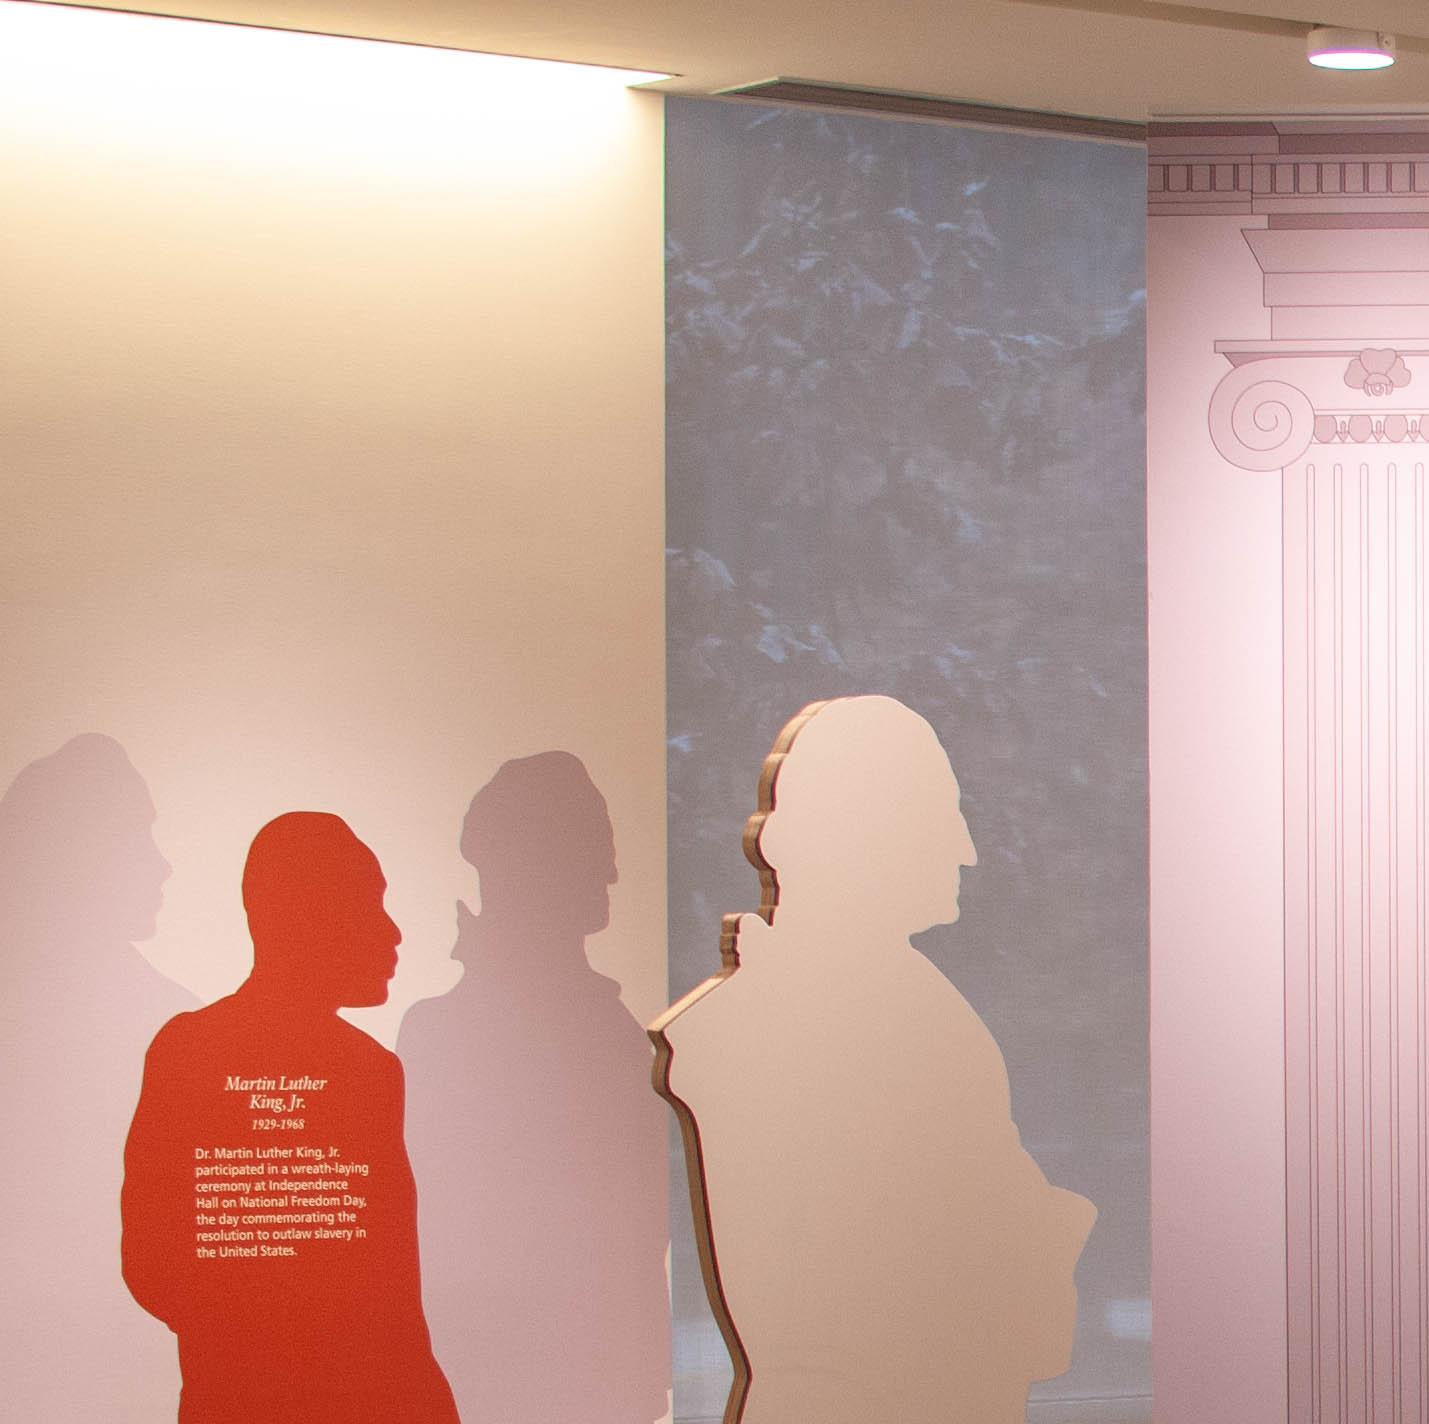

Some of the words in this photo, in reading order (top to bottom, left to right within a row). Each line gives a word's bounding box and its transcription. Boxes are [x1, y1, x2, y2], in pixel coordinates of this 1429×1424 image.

[225, 1076, 276, 1091] Martin
[280, 1076, 327, 1091] Luther
[250, 1094, 286, 1112] King,
[288, 1094, 306, 1111] Jr.
[252, 1119, 305, 1130] 1929-1968
[195, 1148, 211, 1159] Dr.
[214, 1147, 253, 1159] Martin
[256, 1147, 293, 1158] Luther
[296, 1147, 325, 1160] King,
[328, 1147, 340, 1158] Jr.
[195, 1164, 264, 1178] participated
[267, 1164, 279, 1175] in
[281, 1166, 288, 1175] a
[291, 1163, 369, 1176] wreath-laying
[195, 1182, 251, 1194] ceremony
[254, 1181, 266, 1191] at
[269, 1180, 349, 1192] Independence
[196, 1197, 219, 1208] Hall
[221, 1199, 237, 1208] on
[240, 1196, 288, 1208] National
[291, 1195, 340, 1207] Freedom
[343, 1195, 367, 1209] Day,
[197, 1213, 216, 1224] the
[219, 1213, 239, 1227] day
[242, 1212, 335, 1226] commemorating
[338, 1212, 356, 1222] the
[197, 1229, 254, 1241] resolution
[257, 1230, 270, 1240] to
[273, 1228, 312, 1240] outlaw
[315, 1228, 352, 1242] slavery
[355, 1228, 366, 1238] in
[197, 1246, 216, 1257] the
[219, 1245, 257, 1257] United
[260, 1245, 297, 1256] States.
